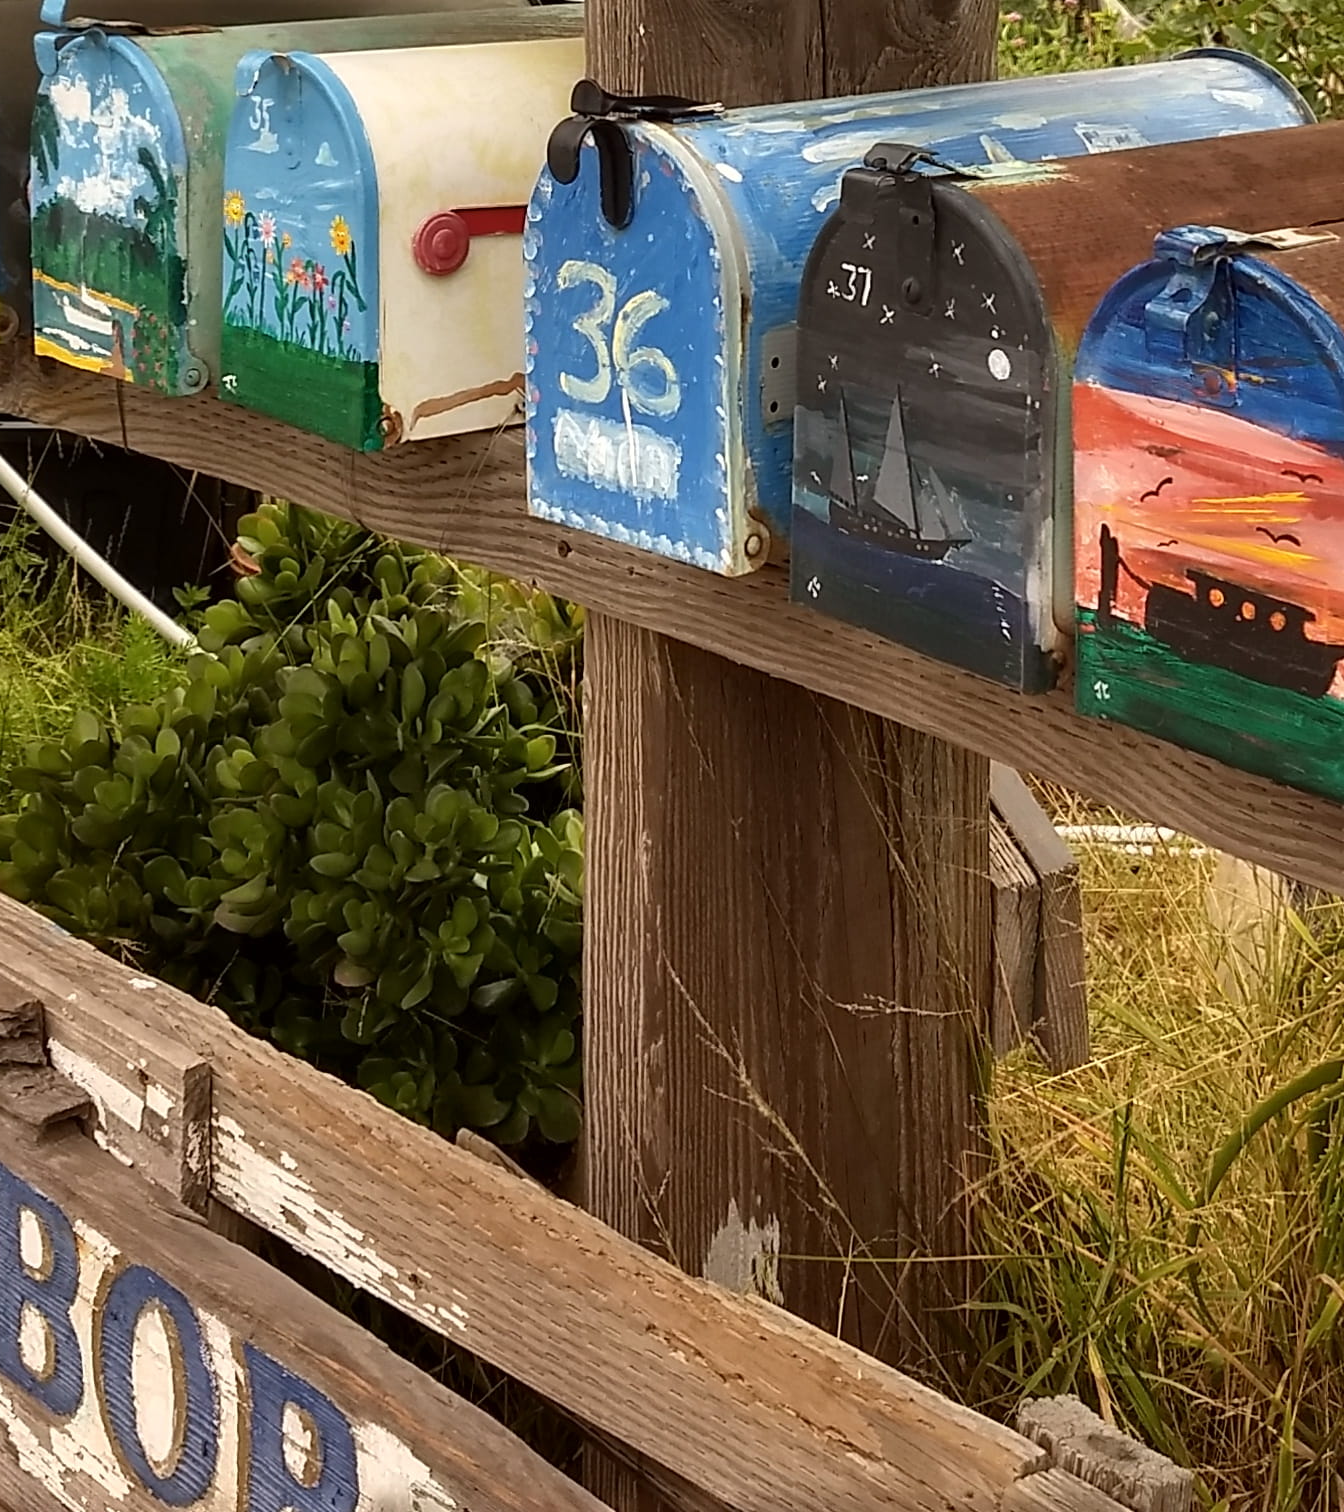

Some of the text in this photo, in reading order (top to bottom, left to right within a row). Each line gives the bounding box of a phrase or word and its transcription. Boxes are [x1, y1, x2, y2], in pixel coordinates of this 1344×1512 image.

[249, 95, 275, 131] 35
[841, 263, 871, 306] 37
[557, 260, 681, 421] 36
